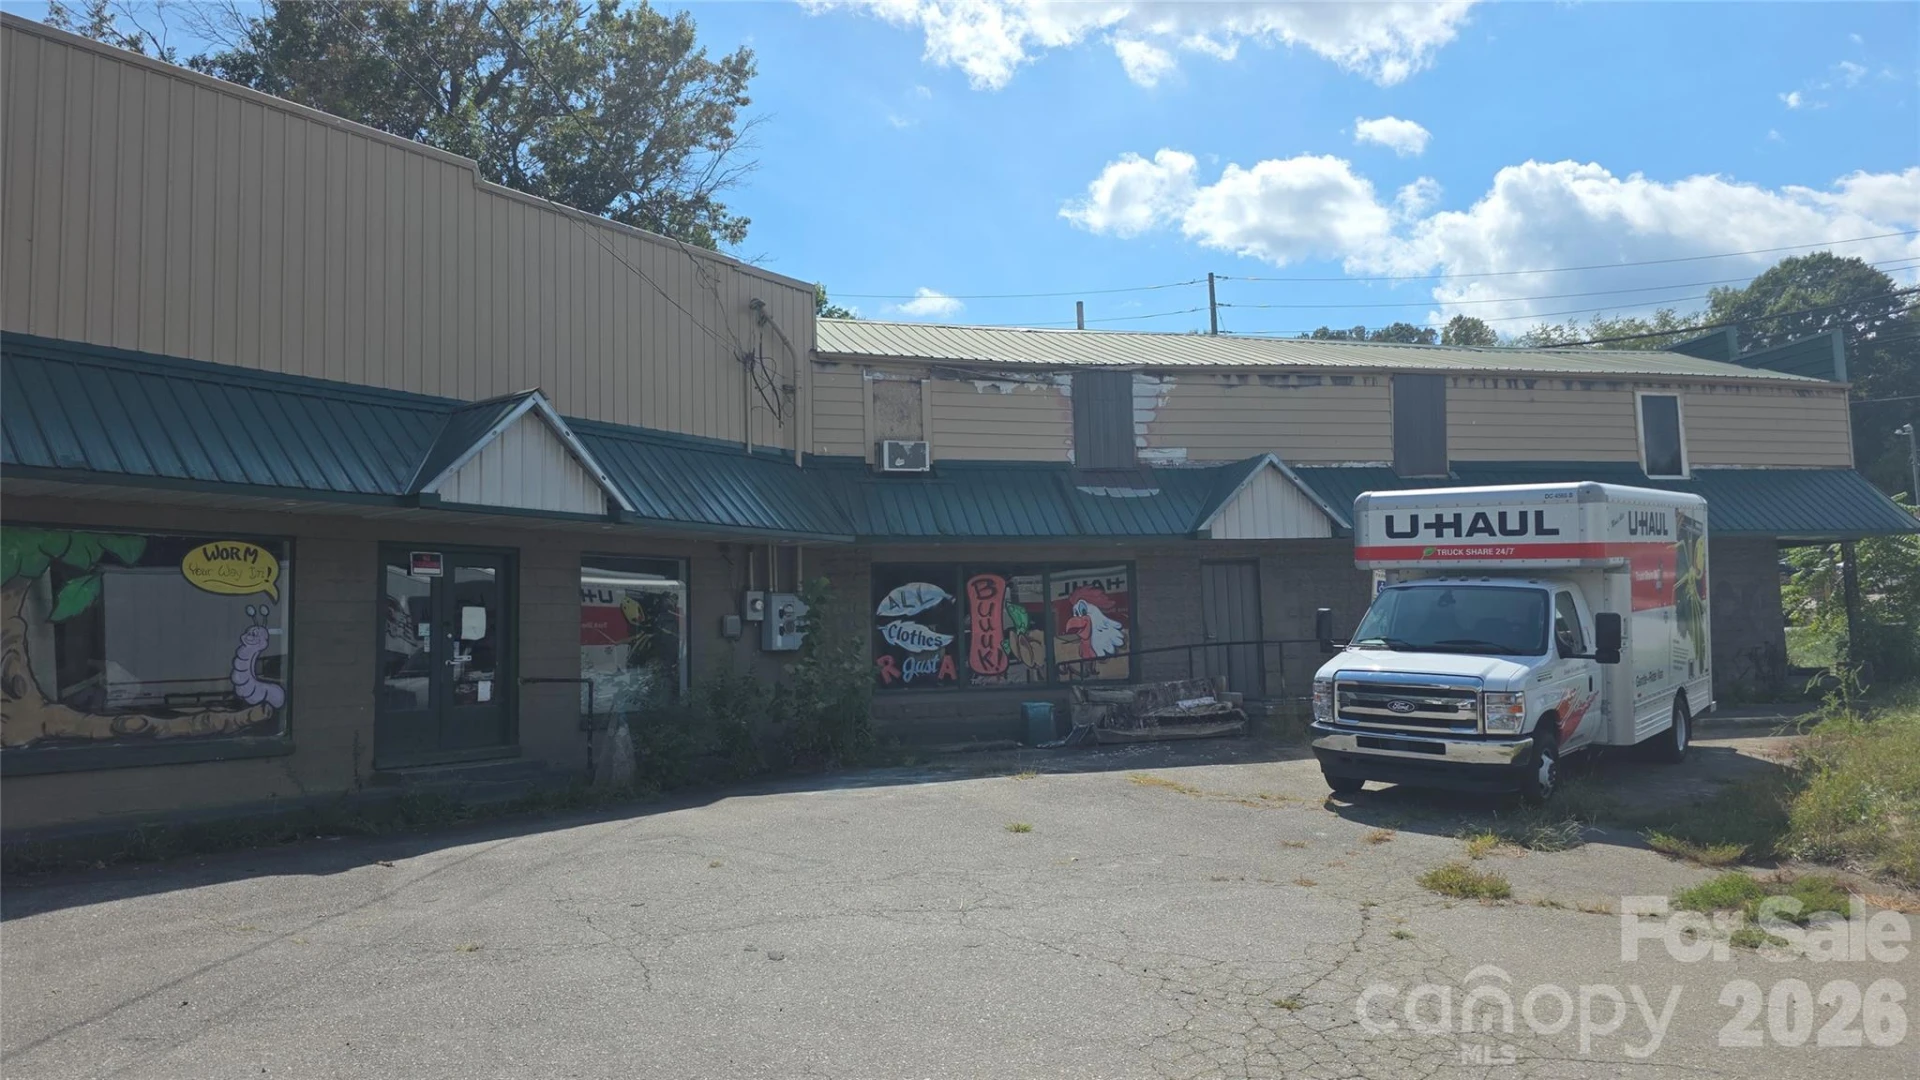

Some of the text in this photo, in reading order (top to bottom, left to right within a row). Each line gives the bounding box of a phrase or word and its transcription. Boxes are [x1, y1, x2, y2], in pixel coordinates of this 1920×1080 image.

[202, 544, 259, 565] WORM
[1436, 547, 1516, 557] TRUCK SHARE 24/7
[887, 584, 936, 611] ALL
[888, 624, 943, 647] Clothes
[876, 654, 902, 684] R
[938, 654, 958, 680] A
[1390, 701, 1411, 711] Ford
